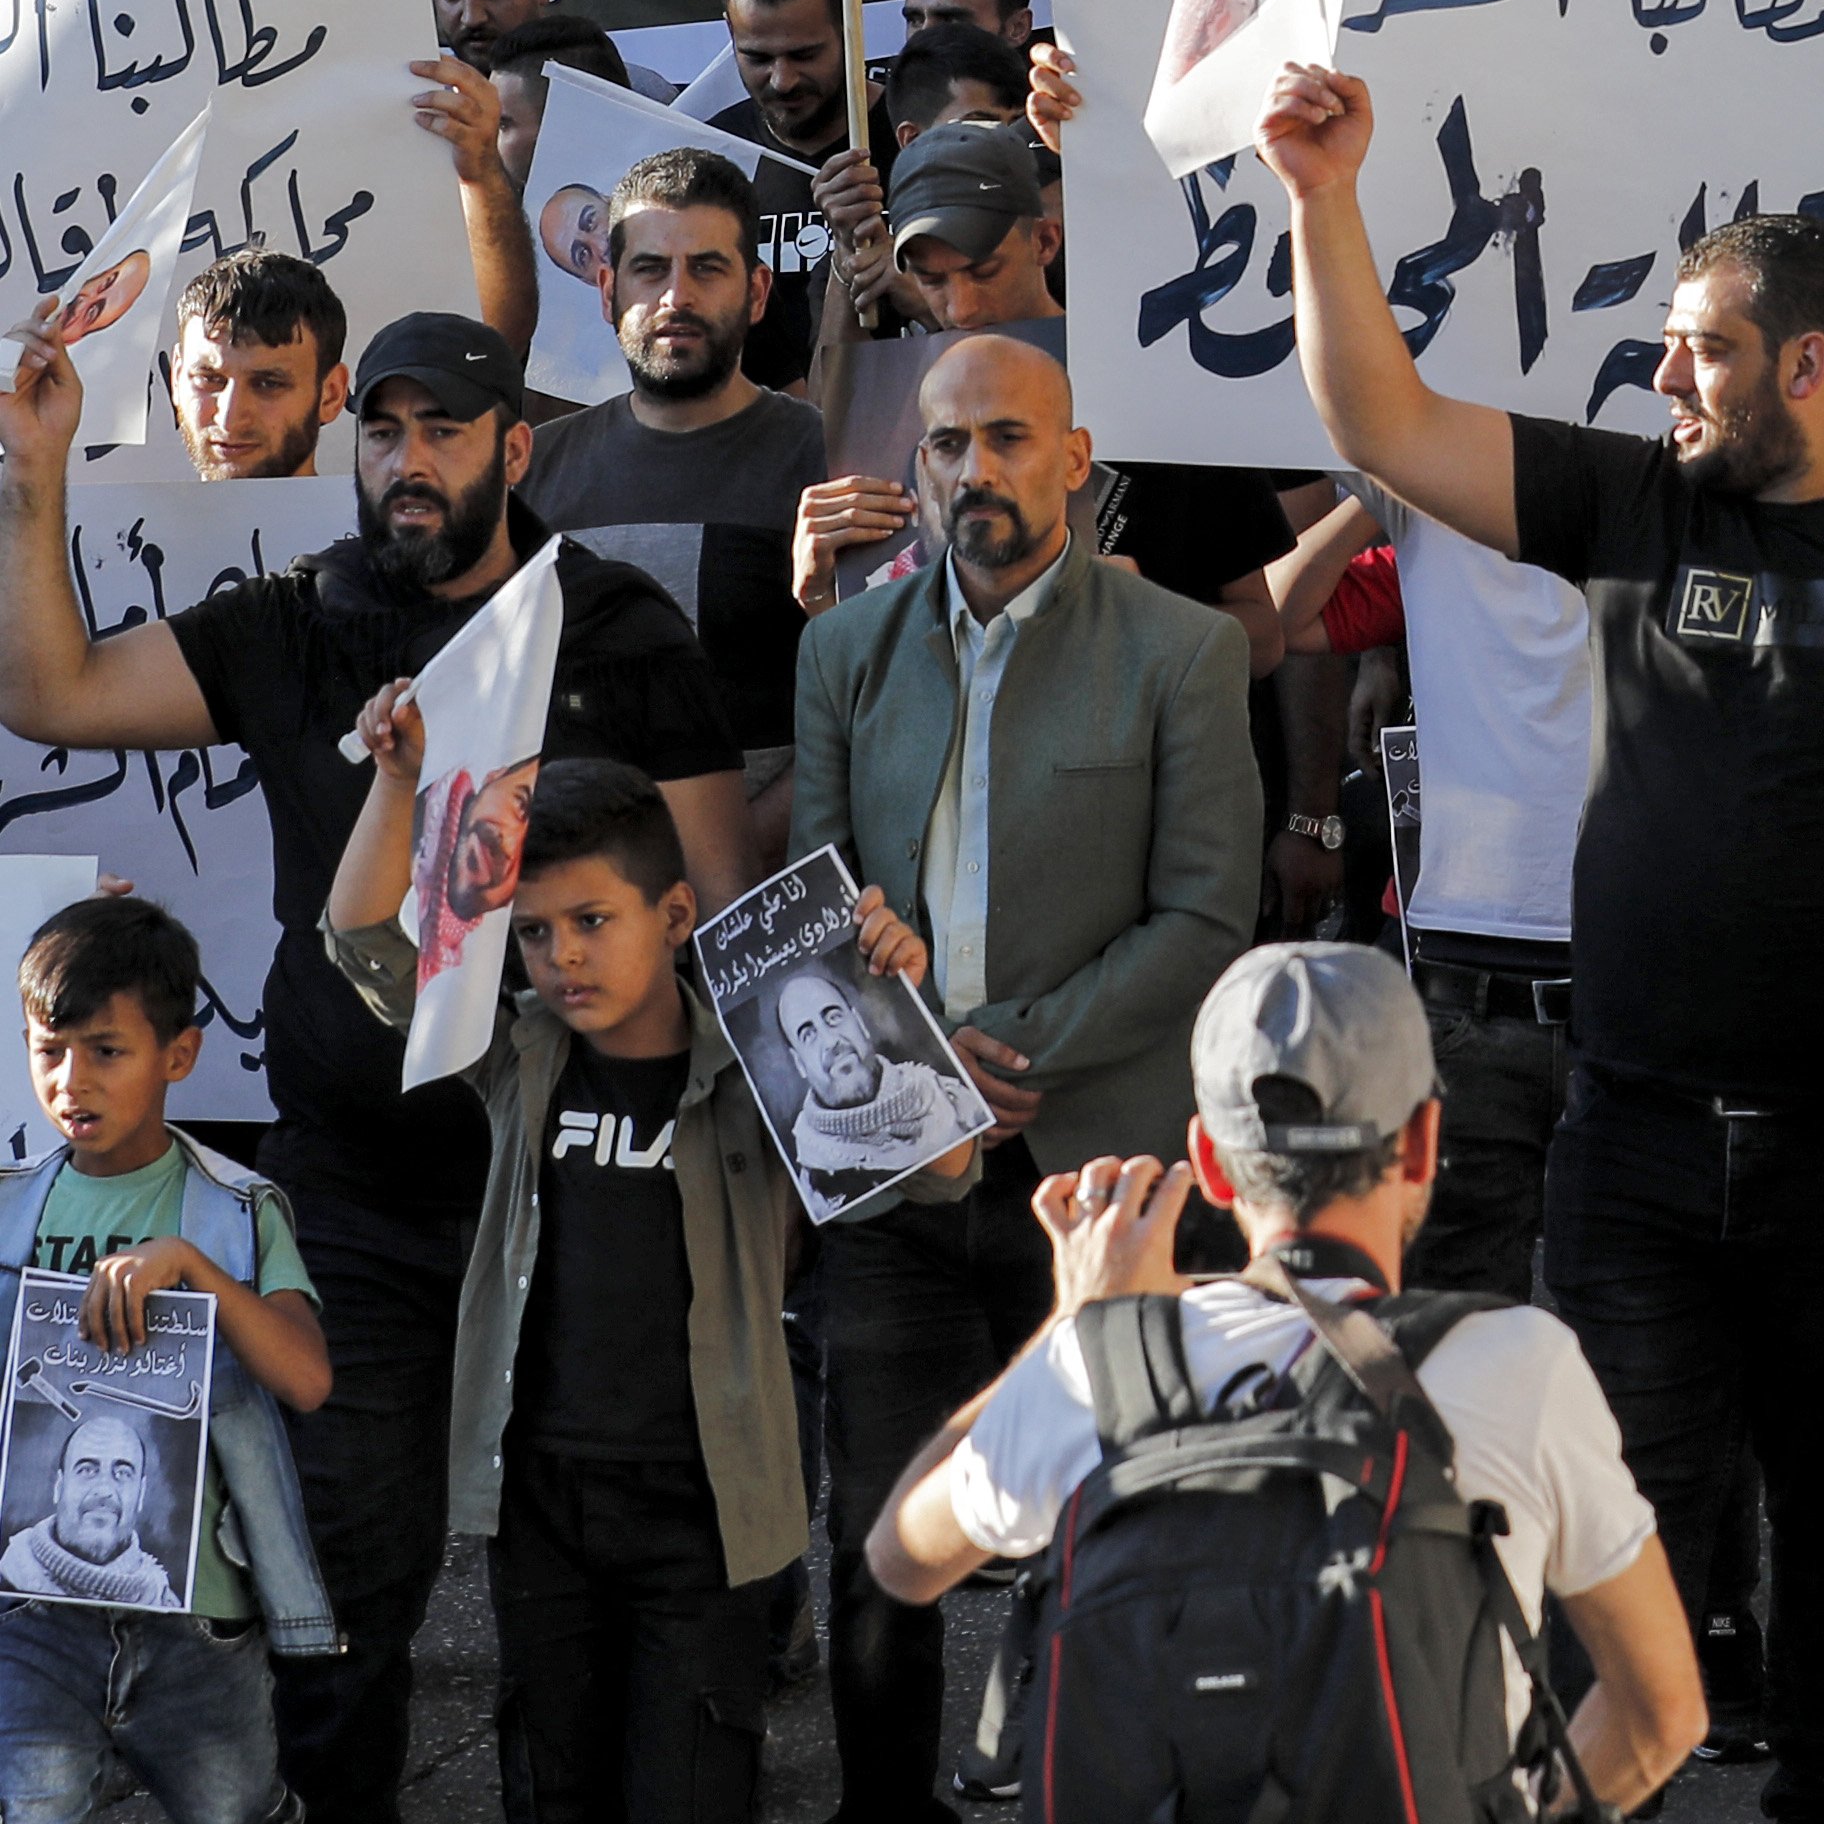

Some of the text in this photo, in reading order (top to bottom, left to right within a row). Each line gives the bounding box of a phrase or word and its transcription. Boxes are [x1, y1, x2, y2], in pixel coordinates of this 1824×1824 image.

[1687, 583, 1742, 622] RV
[779, 872, 808, 903] انا
[716, 909, 753, 951] علشان
[744, 937, 803, 978] يعيشوا
[26, 1297, 209, 1337] سلطتنا تلات
[43, 1342, 89, 1374] بنات
